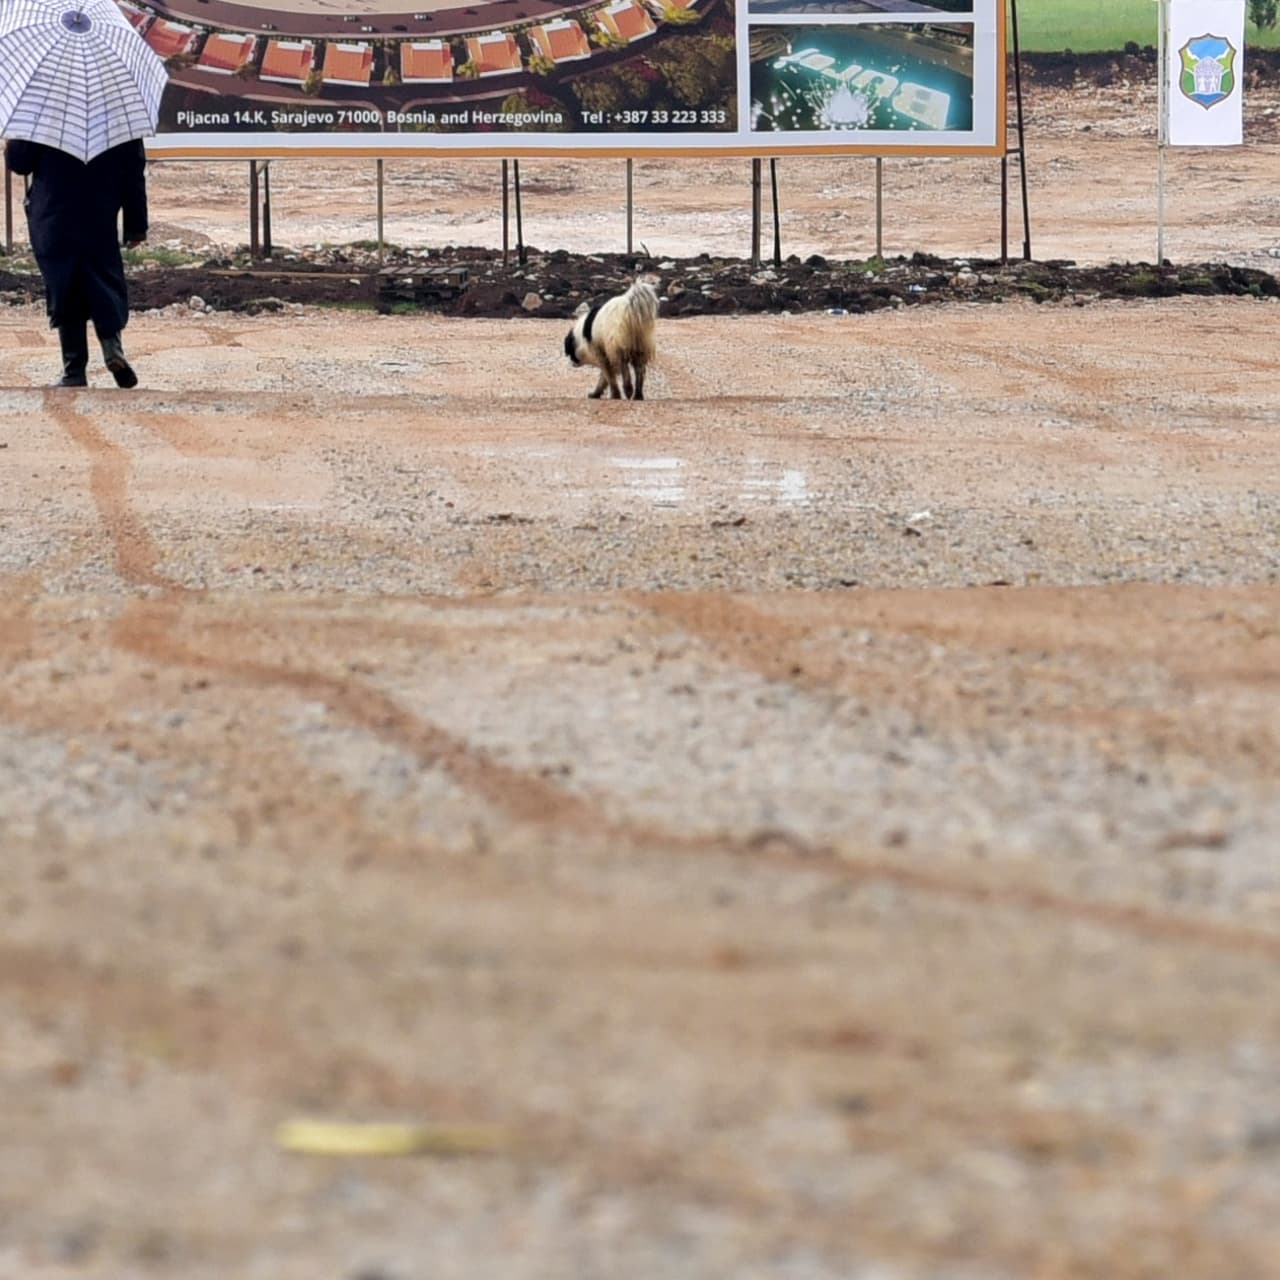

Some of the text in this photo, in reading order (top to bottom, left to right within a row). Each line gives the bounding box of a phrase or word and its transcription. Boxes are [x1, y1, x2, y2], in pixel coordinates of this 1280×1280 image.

[176, 110, 562, 128] Pijacna 14.K, Sarajevo 71000, Bosnia and Herzegovina
[581, 111, 603, 124] Tel
[614, 110, 648, 124] +387
[651, 110, 669, 124] 33
[671, 110, 697, 124] 223
[700, 110, 726, 124] 333
